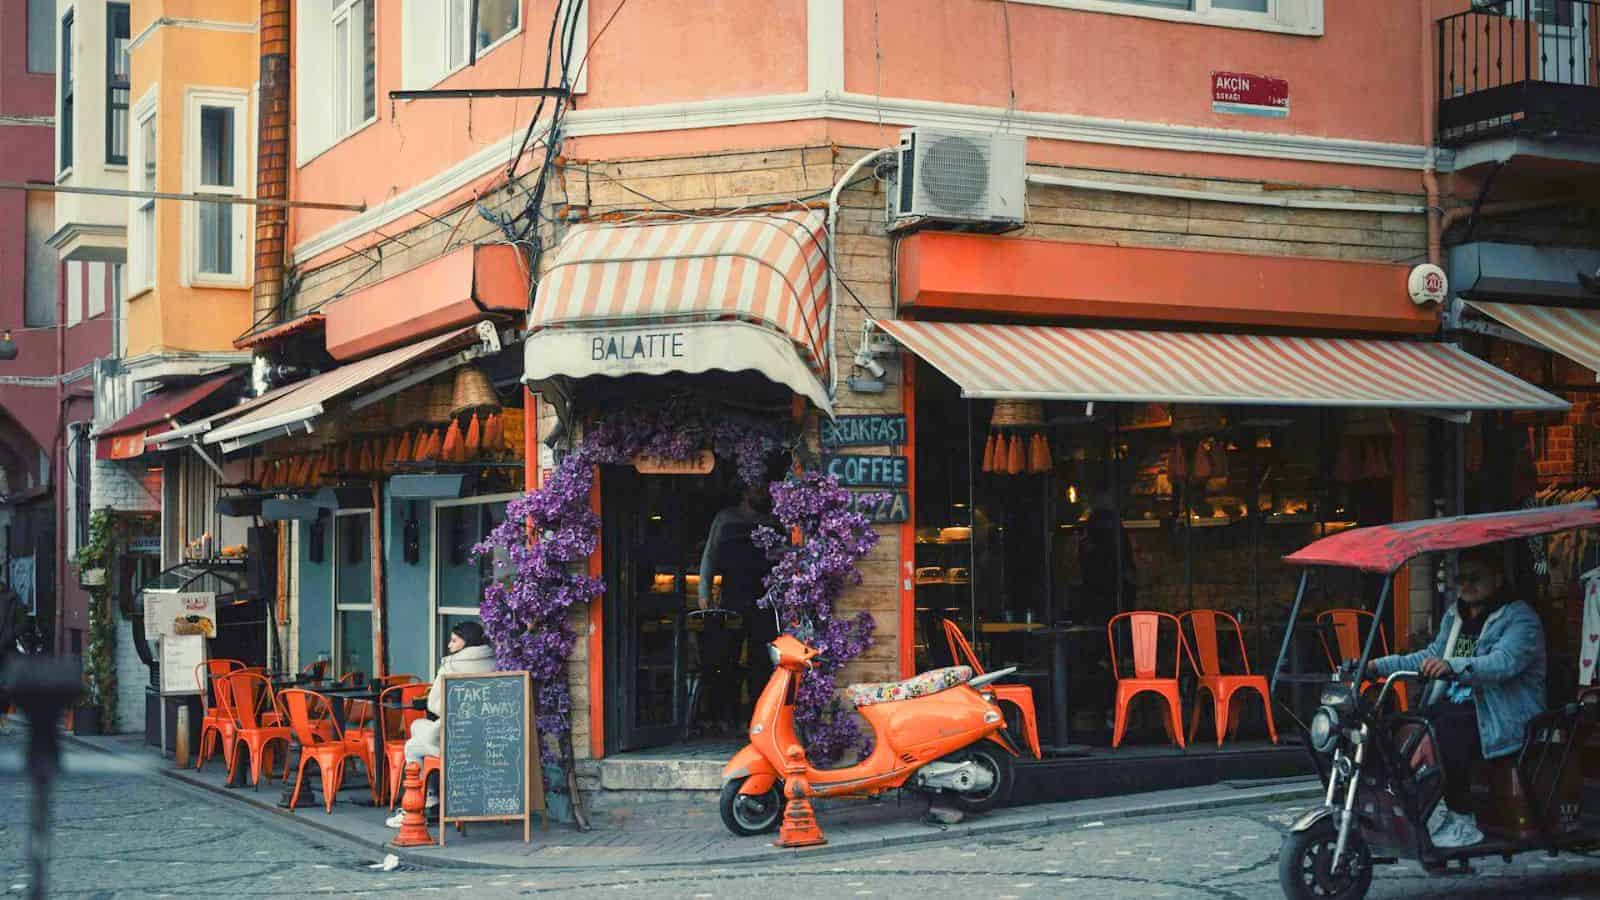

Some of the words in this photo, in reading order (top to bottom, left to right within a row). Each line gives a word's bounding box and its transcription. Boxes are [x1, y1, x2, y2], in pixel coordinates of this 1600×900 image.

[1216, 77, 1250, 93] AKÇİN
[592, 332, 684, 361] BALATTE
[820, 417, 907, 442] BREAKFAST
[828, 456, 905, 485] COFFEE
[454, 687, 491, 702] TAKE
[481, 702, 514, 716] AWAY
